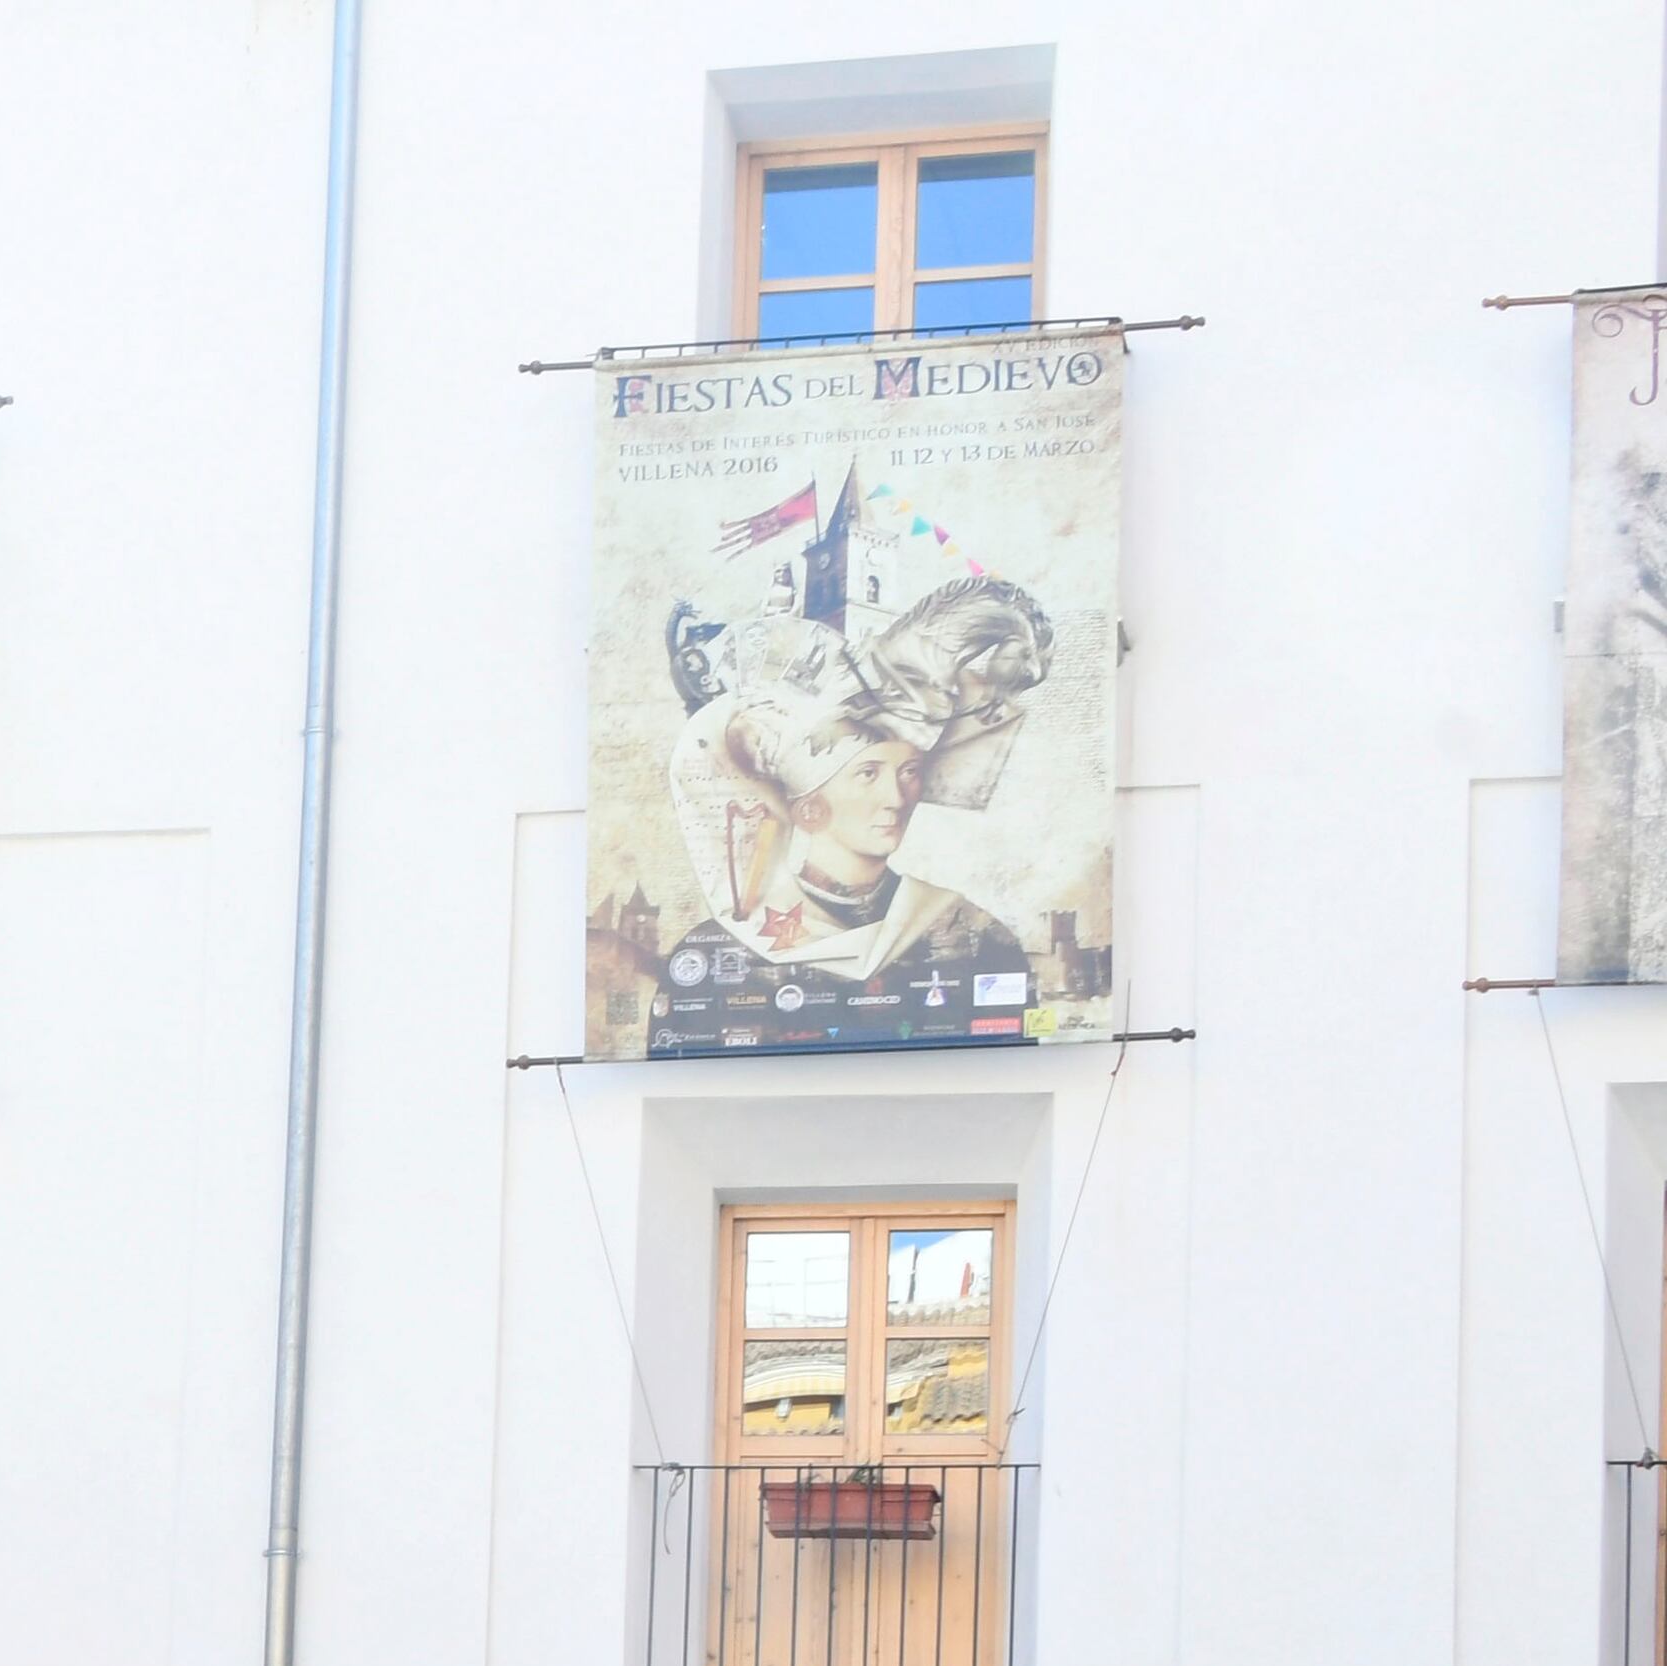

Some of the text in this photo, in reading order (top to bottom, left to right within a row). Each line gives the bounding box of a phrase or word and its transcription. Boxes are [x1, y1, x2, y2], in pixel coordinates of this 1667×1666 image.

[613, 352, 1103, 417] FIESTAS DEL MEDIEVO
[619, 442, 683, 456] FIESTAS
[691, 439, 715, 451] DE
[898, 426, 919, 439] EN
[927, 422, 987, 436] HONOR
[998, 421, 1007, 431] A
[1014, 417, 1047, 431] SAN
[891, 440, 1095, 466] 11 12 Y 13 DE MARZO
[619, 457, 778, 482] VILLENA 2016
